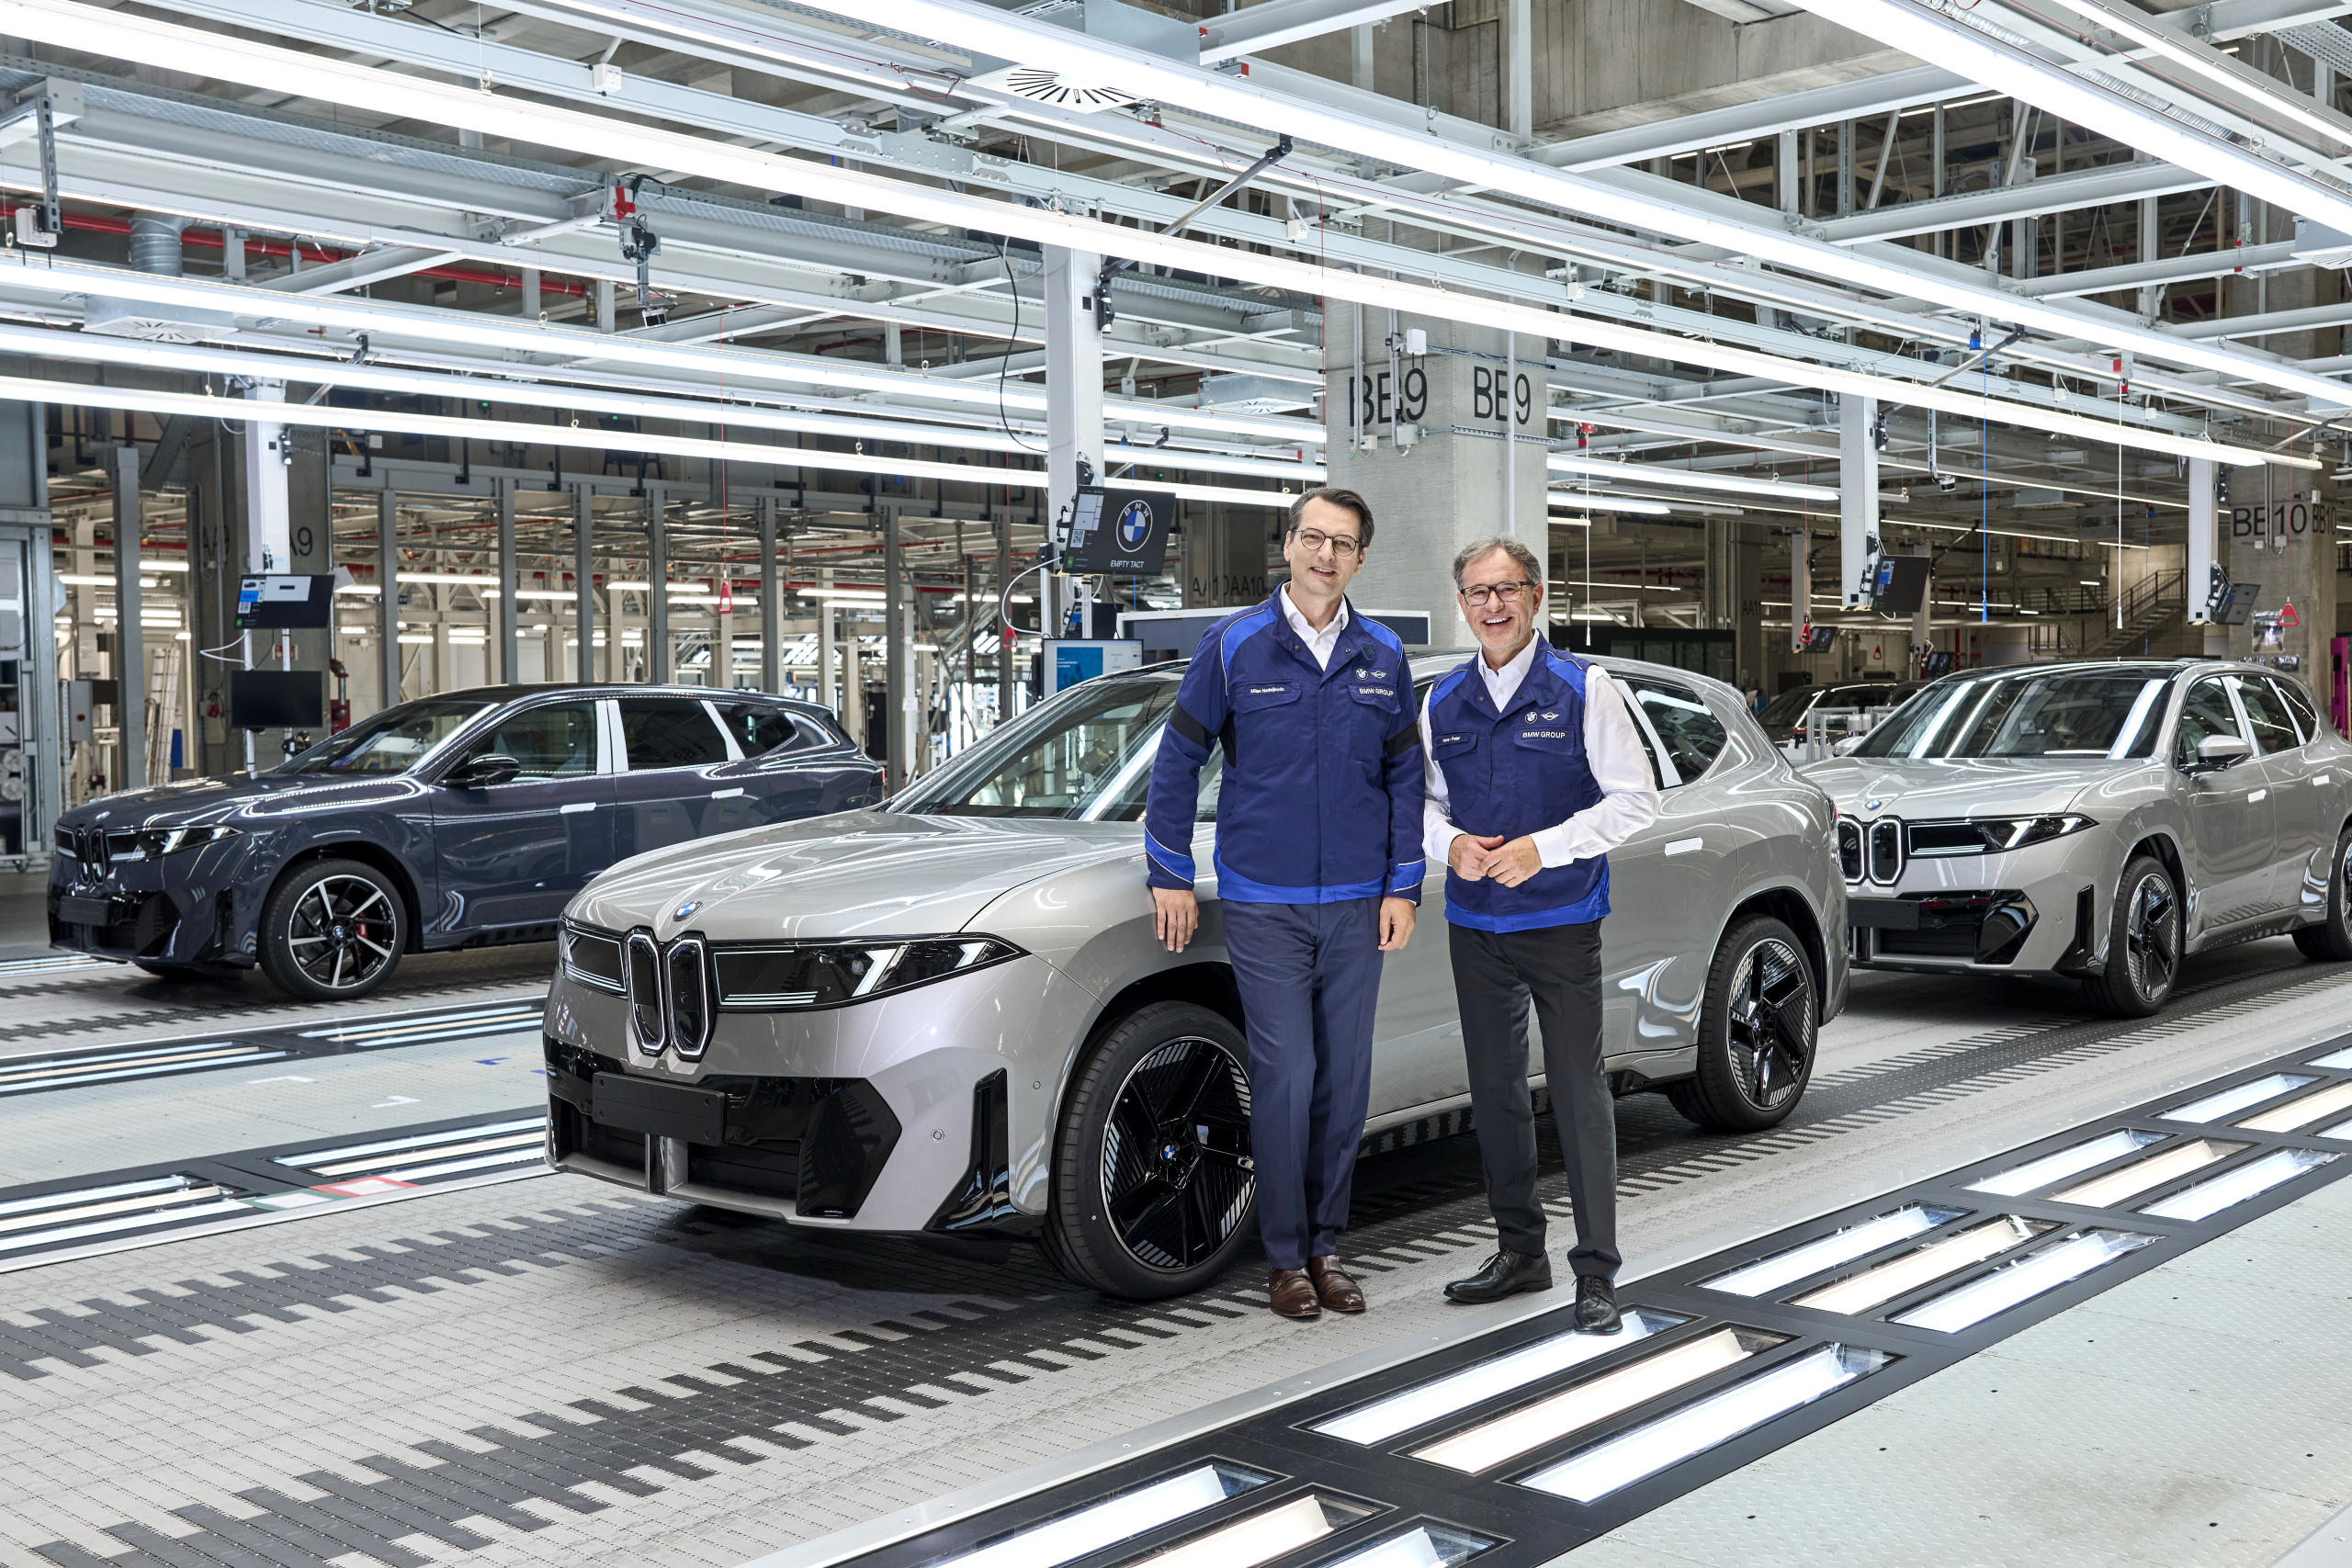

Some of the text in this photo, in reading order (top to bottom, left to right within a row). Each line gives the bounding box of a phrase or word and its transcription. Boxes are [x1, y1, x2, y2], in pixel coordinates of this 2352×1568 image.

[1110, 559, 1145, 569] EMPTY TACT
[1229, 575, 1265, 597] AA10
[1374, 688, 1394, 696] GROUP
